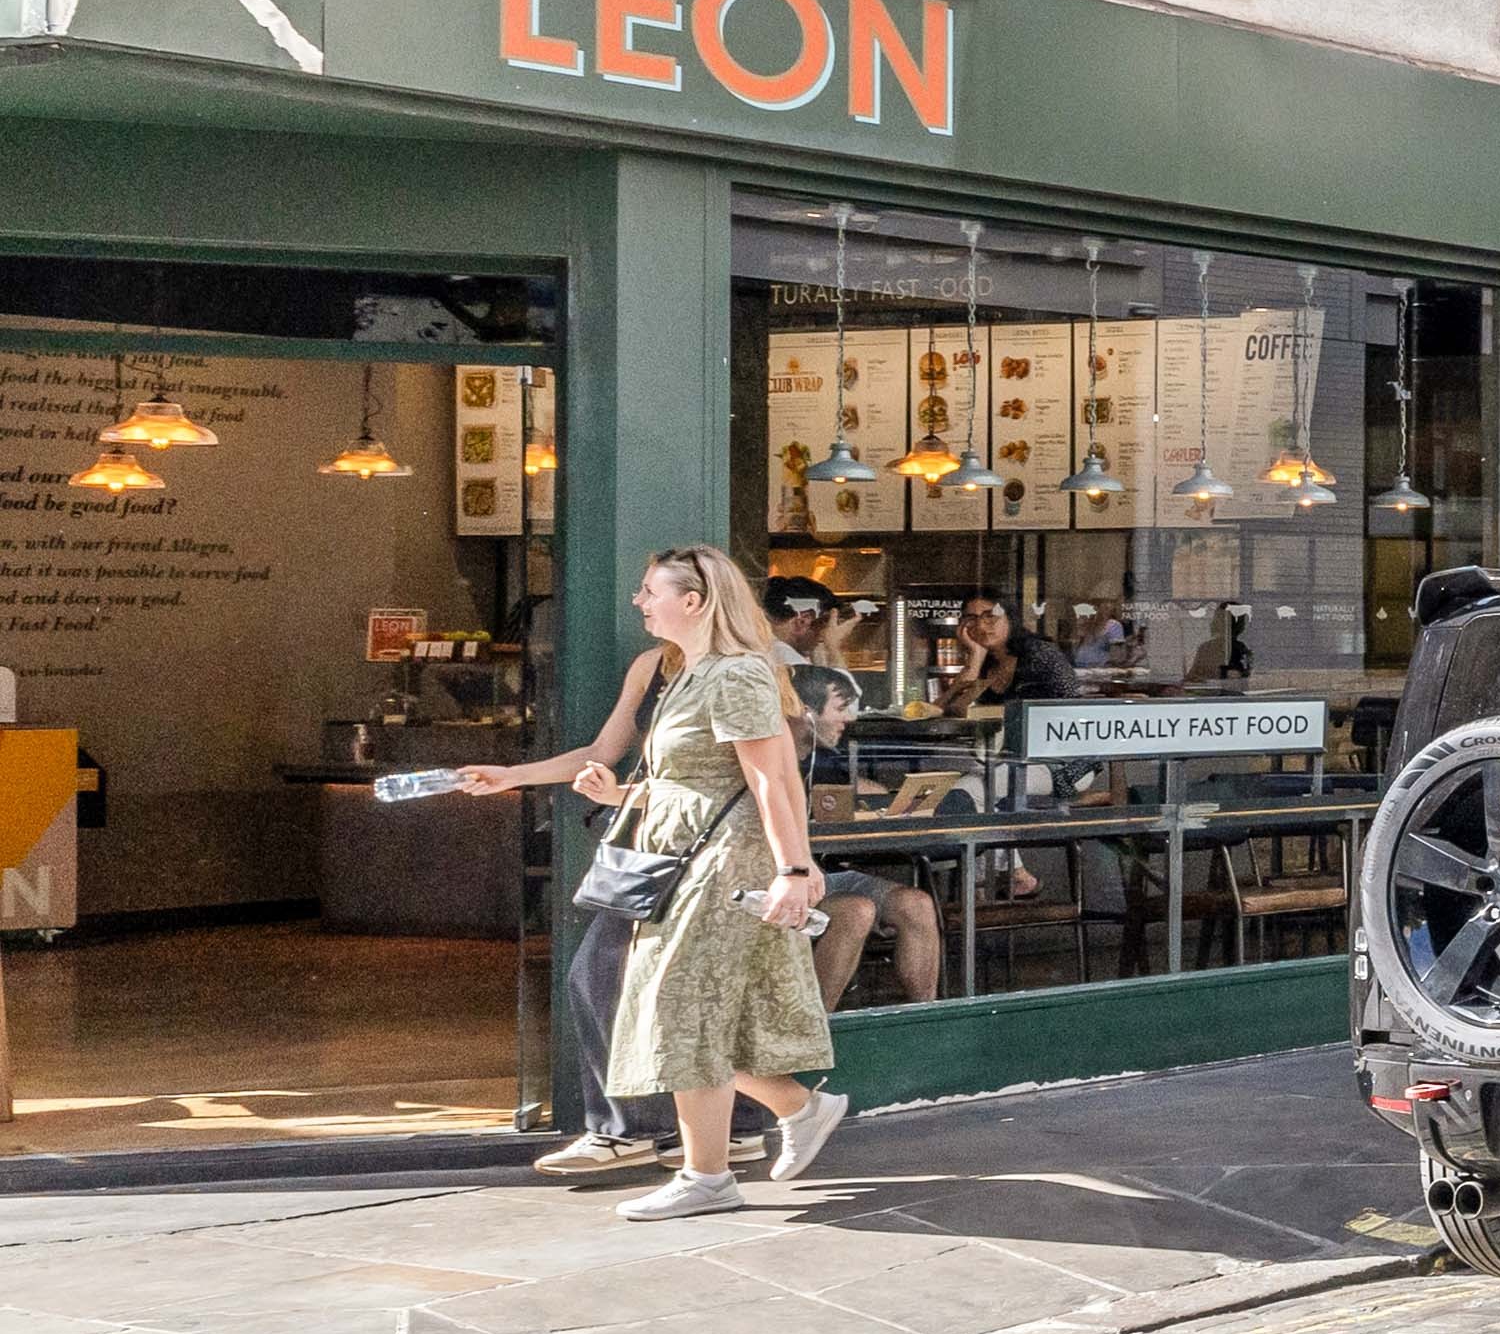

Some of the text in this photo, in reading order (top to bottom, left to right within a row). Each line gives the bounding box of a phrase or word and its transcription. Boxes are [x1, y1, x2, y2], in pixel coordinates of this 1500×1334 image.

[871, 278, 920, 301] FAST
[1, 369, 40, 385] food
[44, 369, 70, 385] the
[794, 377, 823, 394] WRAP
[10, 399, 82, 415] realised
[208, 410, 244, 425] food
[39, 427, 59, 439] or
[43, 493, 66, 511] be
[70, 497, 119, 518] good
[120, 497, 178, 519] food?
[25, 535, 66, 551] with
[70, 539, 103, 552] our
[103, 537, 163, 556] friend
[37, 563, 53, 578] it
[57, 567, 91, 579] was
[95, 564, 165, 583] possible
[168, 565, 187, 580] to
[231, 566, 271, 585] food
[22, 590, 59, 606] and
[63, 590, 101, 606] does
[106, 594, 137, 609] you
[141, 591, 187, 610] good.
[907, 599, 964, 610] NATURALLY
[1121, 603, 1171, 613] NATURALLY
[907, 609, 931, 619] FAST
[1121, 611, 1170, 621] FAST FOOD
[1312, 604, 1357, 614] NATURALLY
[1312, 612, 1356, 622] FAST FOOD
[8, 616, 49, 632] Fast
[1046, 715, 1309, 742] NATURALLY FAST FOOD
